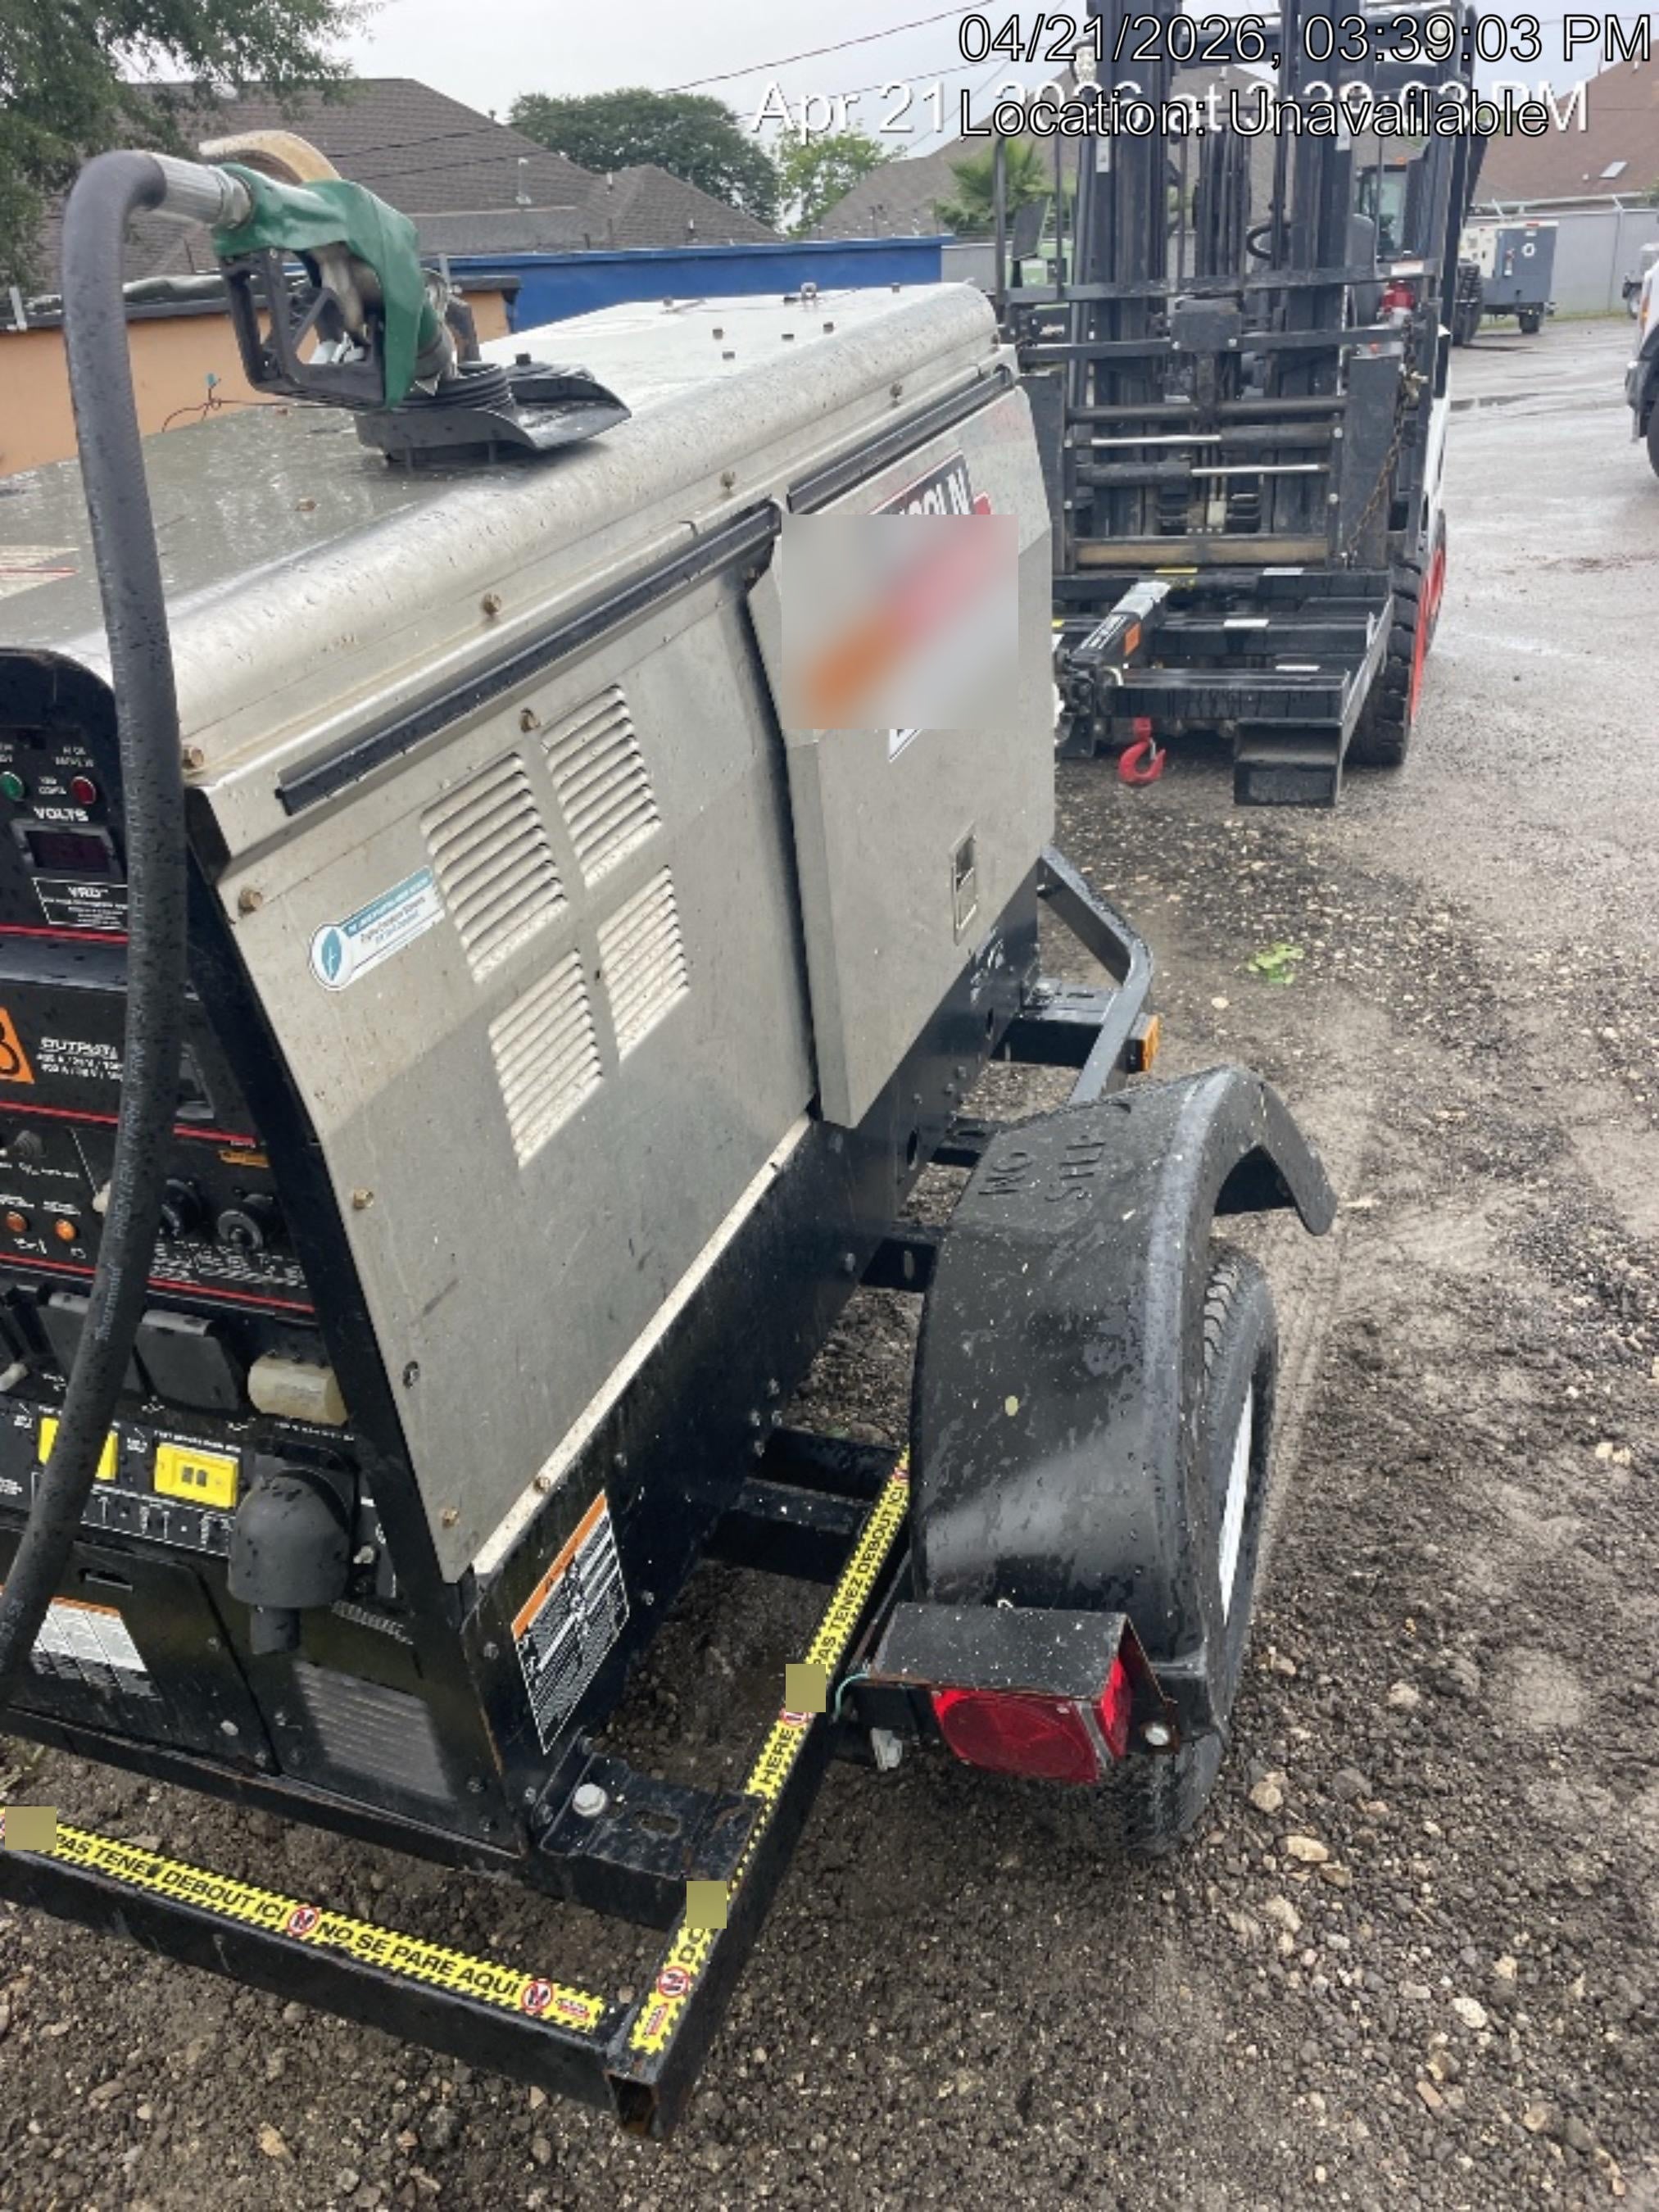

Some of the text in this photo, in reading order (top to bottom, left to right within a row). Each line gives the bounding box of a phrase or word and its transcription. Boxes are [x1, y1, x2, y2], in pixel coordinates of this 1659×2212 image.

[34, 805, 89, 822] VOLTS
[827, 1577, 863, 1631] TENEZ
[858, 1507, 891, 1575] DEBOUT
[887, 1484, 905, 1507] ICI
[759, 1726, 796, 1786] HERE
[95, 1845, 164, 1878] TENE
[164, 1869, 249, 1909] DEBOUT
[255, 1897, 288, 1921] ICI
[315, 1922, 354, 1941] NO
[356, 1932, 392, 1955] SE
[392, 1944, 459, 1976] PARE
